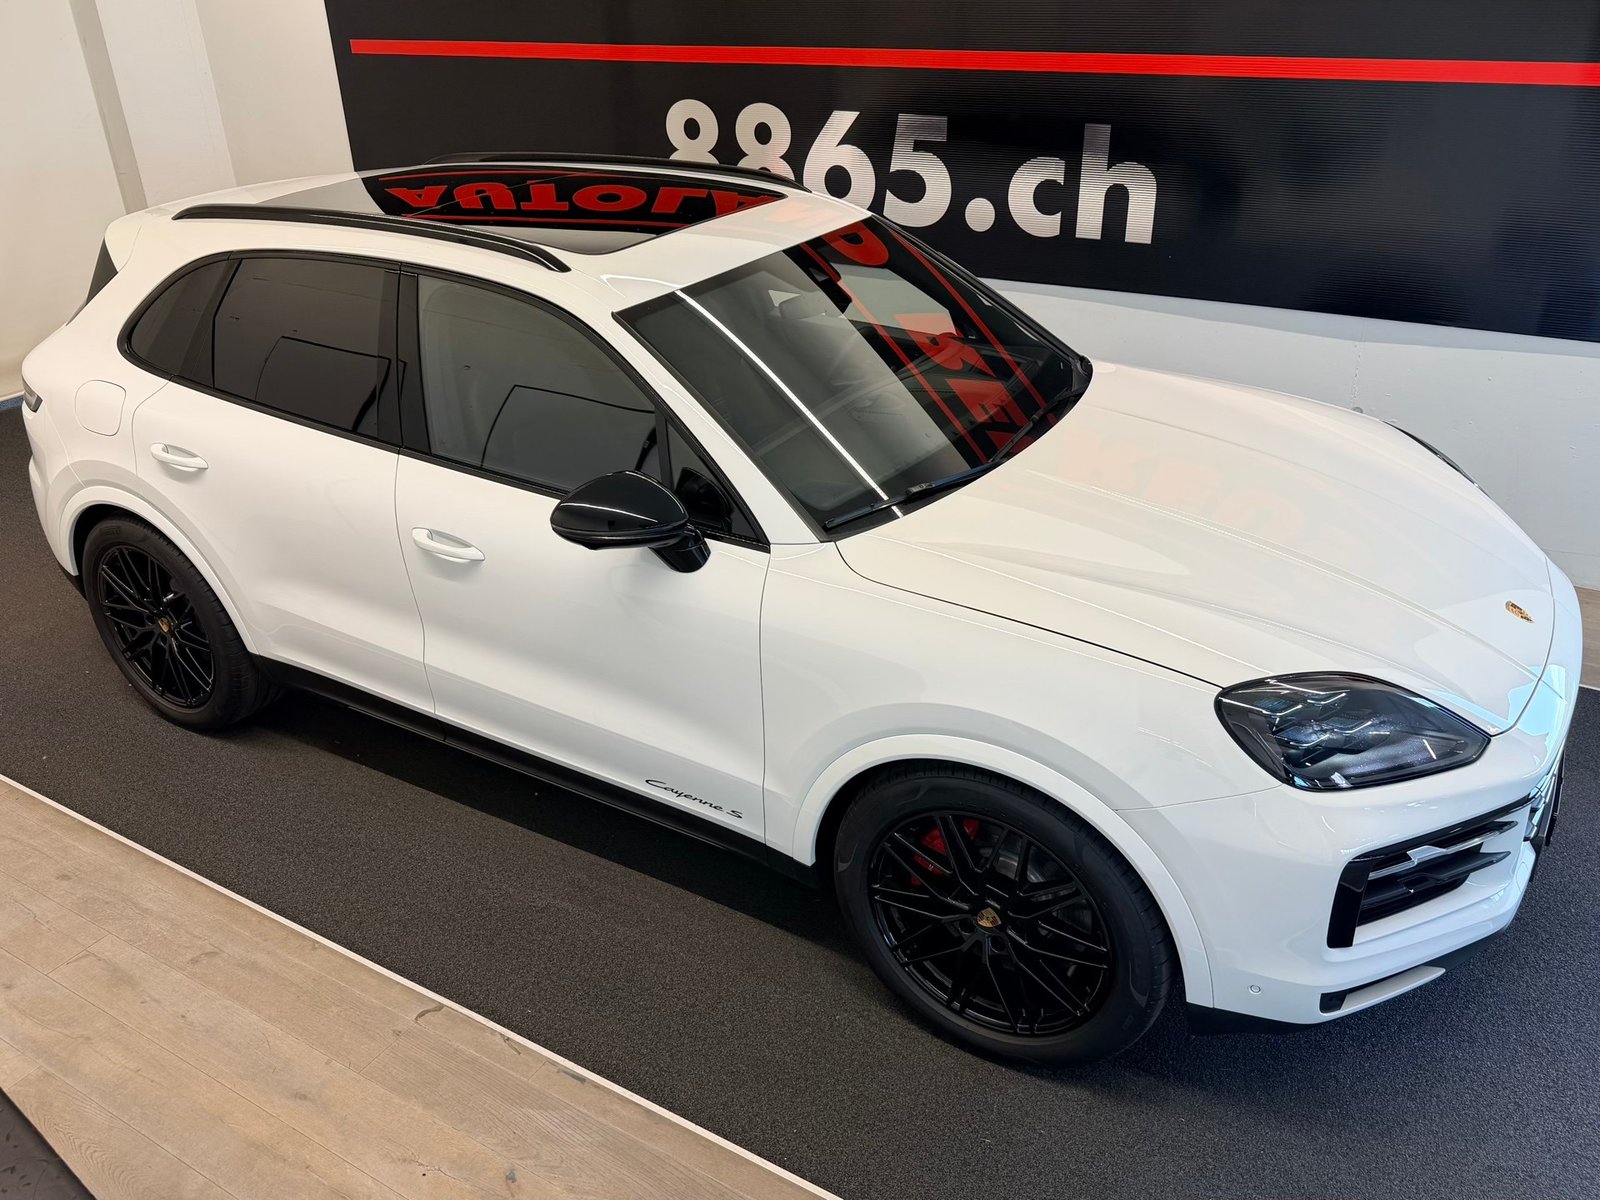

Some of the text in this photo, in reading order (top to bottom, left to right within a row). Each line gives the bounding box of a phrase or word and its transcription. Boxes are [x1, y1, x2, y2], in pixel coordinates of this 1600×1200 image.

[665, 98, 1158, 245] 8865.ch
[645, 779, 743, 819] Cayenne S
